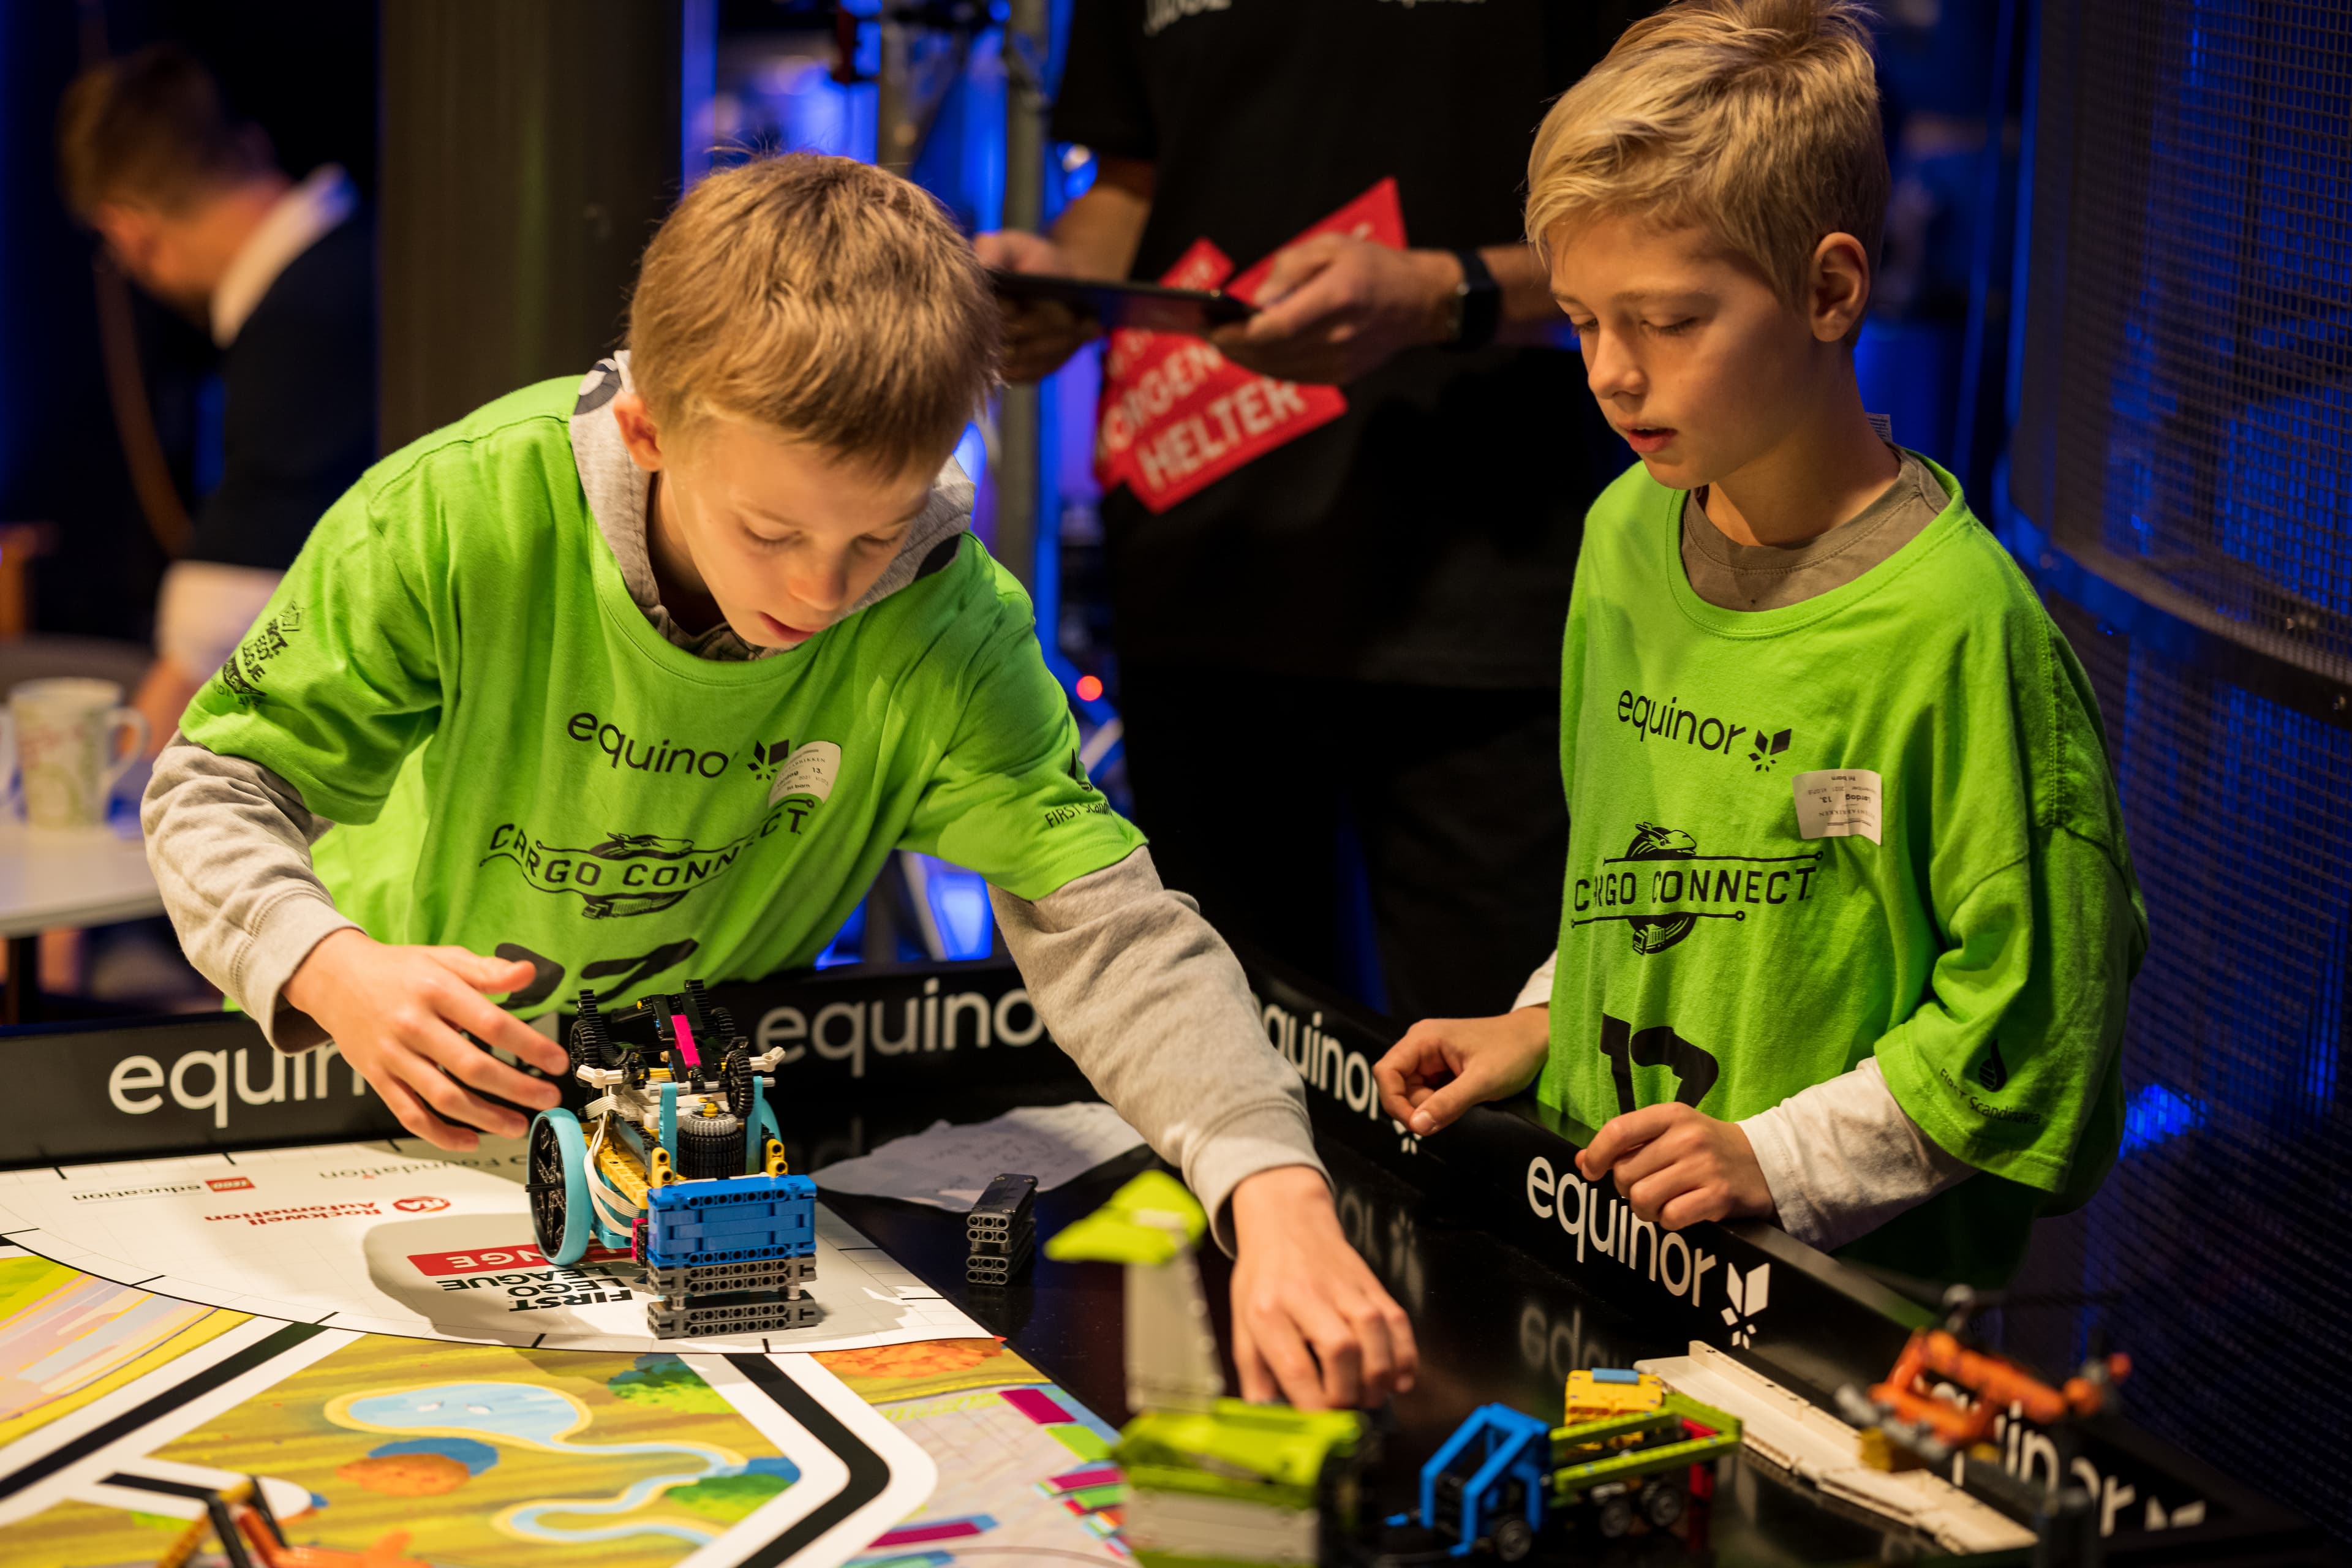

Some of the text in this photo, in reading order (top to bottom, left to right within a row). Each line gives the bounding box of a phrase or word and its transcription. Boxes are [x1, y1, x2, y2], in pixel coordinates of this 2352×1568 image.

[1618, 690, 1746, 755] equinor
[567, 712, 737, 778] equino
[1044, 803, 1080, 827] FIRST
[491, 823, 601, 886] CARGO
[1651, 865, 1817, 904] CONNECT
[756, 978, 1047, 1078] equino
[1256, 995, 1378, 1121] quino
[108, 1041, 366, 1129] equin
[318, 1156, 501, 1180] Foundation
[72, 1183, 202, 1201] education
[204, 1202, 375, 1222] Automation
[248, 1208, 383, 1226] Rockwell
[1527, 1156, 1717, 1308] equinor
[435, 1265, 612, 1291] LEAGUE
[507, 1278, 628, 1297] LEGO
[508, 1289, 634, 1312] FIRST
